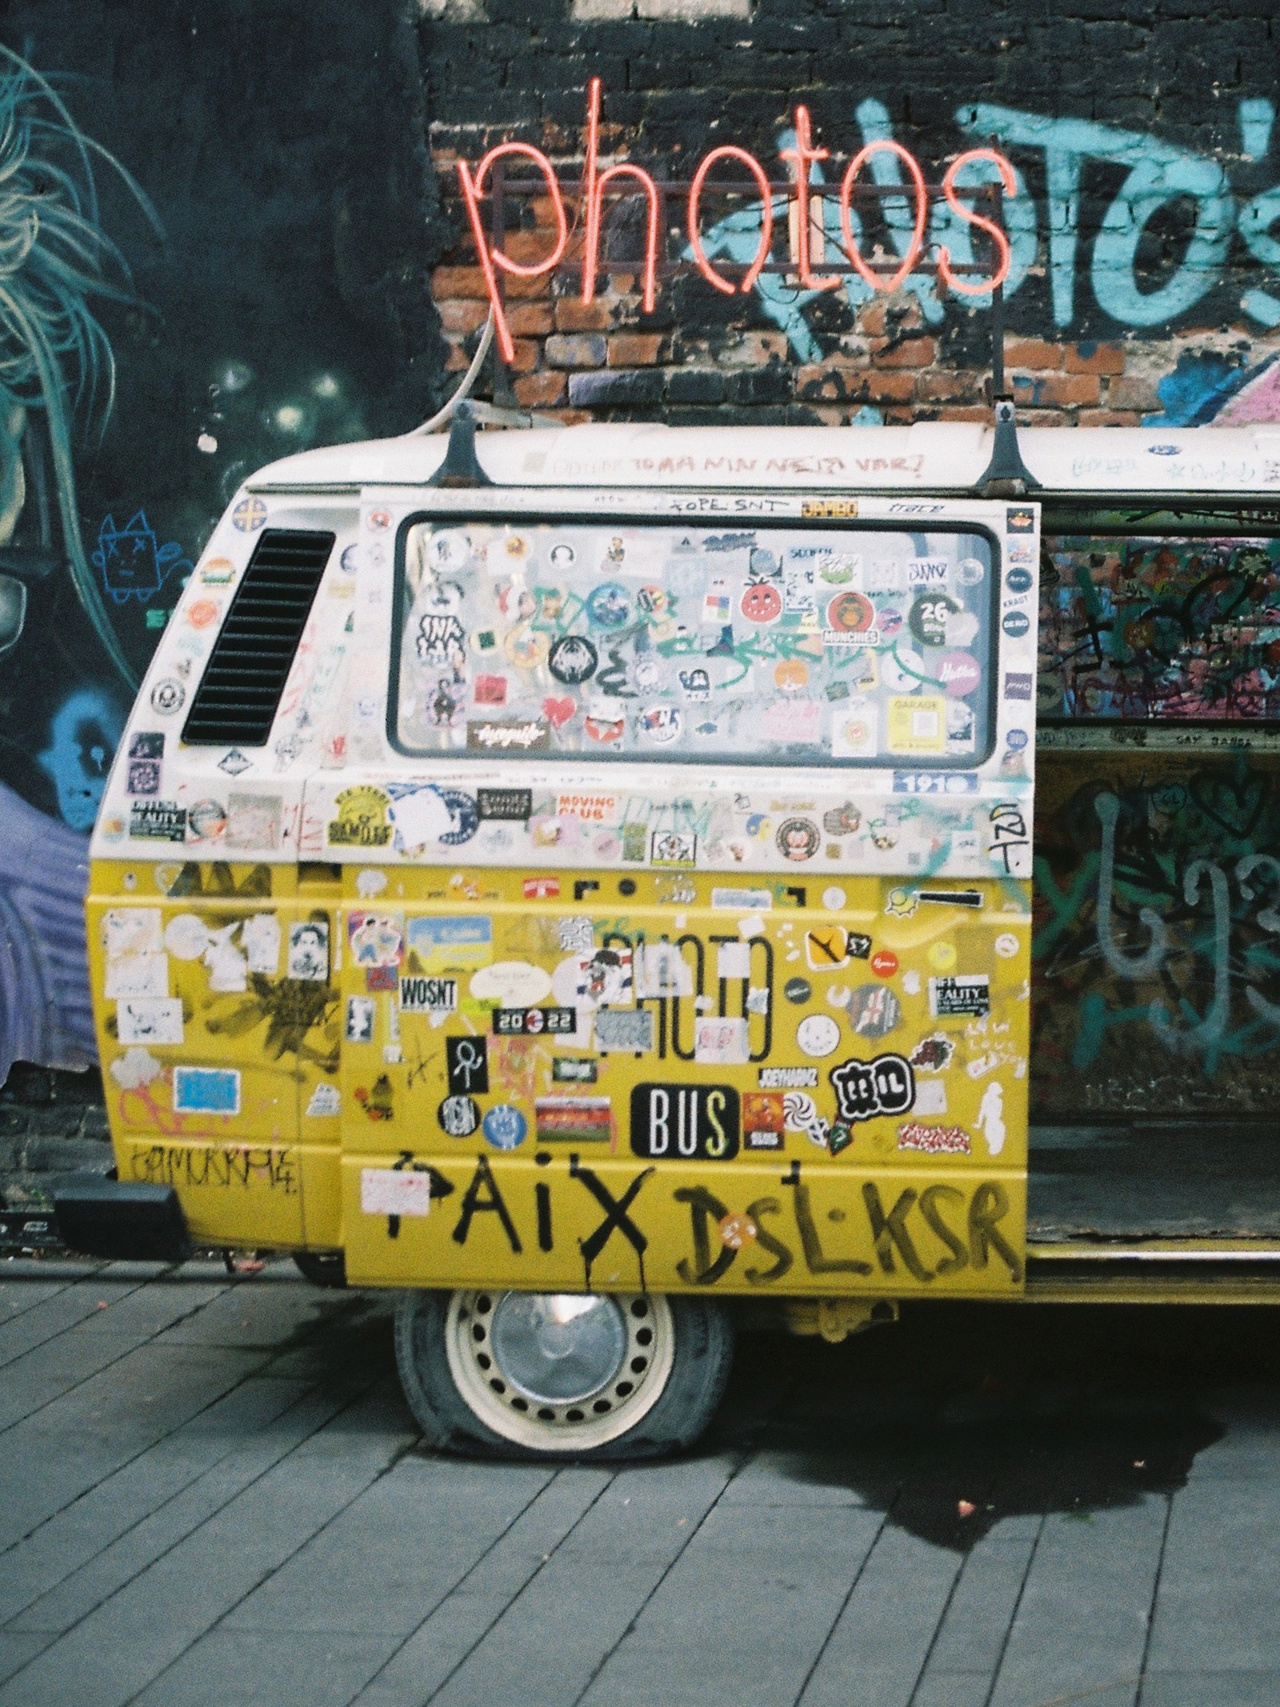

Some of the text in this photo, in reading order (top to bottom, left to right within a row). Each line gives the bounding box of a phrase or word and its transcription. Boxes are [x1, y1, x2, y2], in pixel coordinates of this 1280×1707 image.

[456, 77, 1020, 360] photos
[1002, 595, 1029, 608] KRAUT
[920, 602, 949, 623] 26
[823, 630, 878, 644] MUNCHIES
[559, 795, 616, 807] MOVING
[401, 979, 457, 1005] WOSNT
[936, 988, 981, 999] EALITY
[499, 1014, 571, 1030] 20 22
[648, 1089, 730, 1158] BUS
